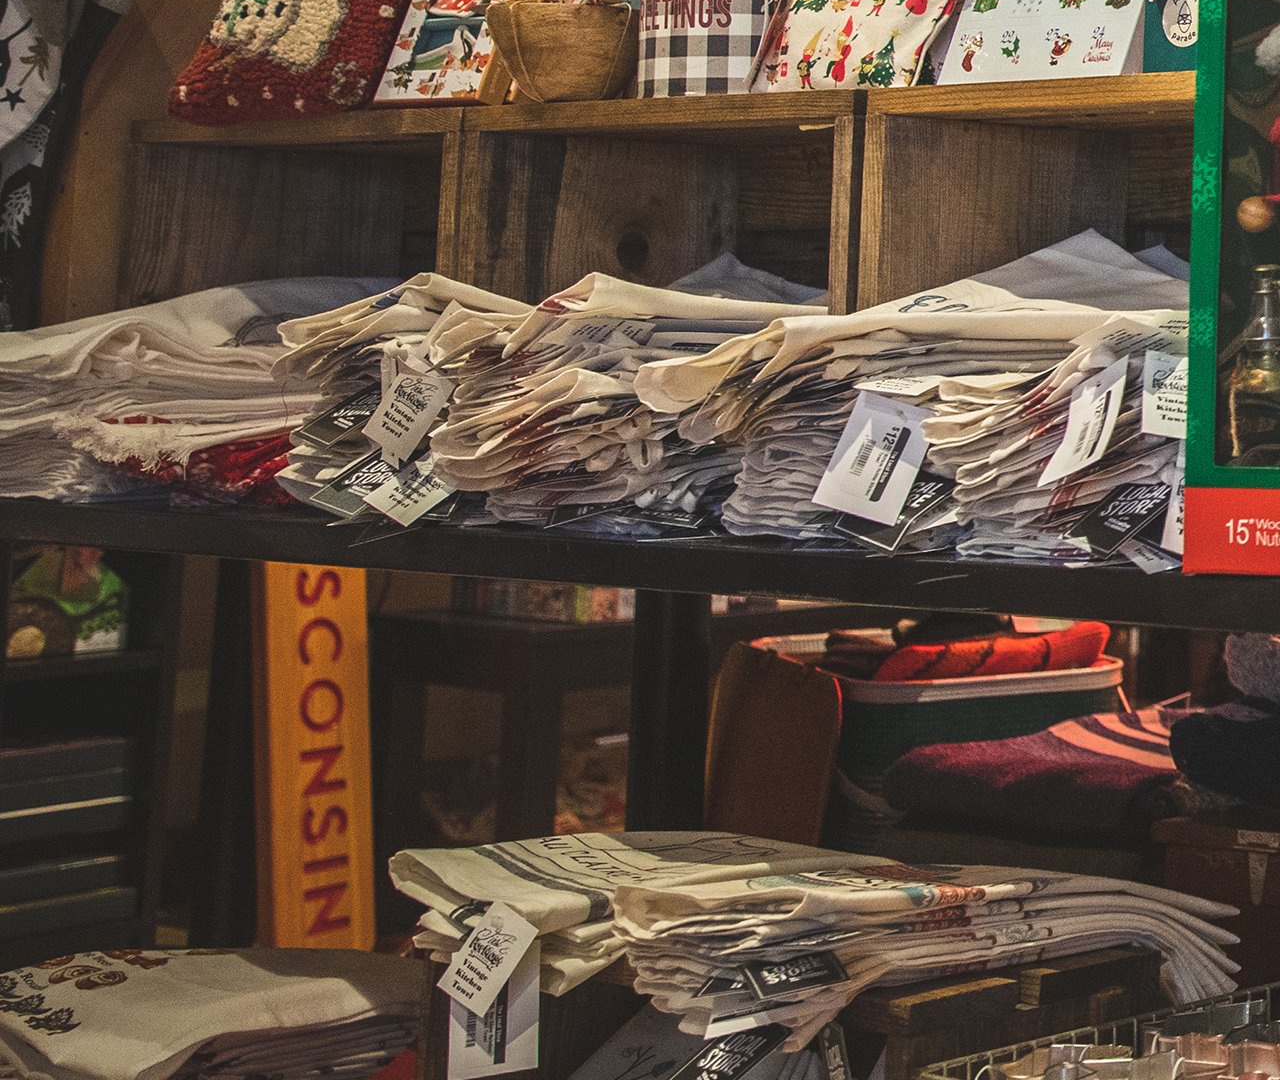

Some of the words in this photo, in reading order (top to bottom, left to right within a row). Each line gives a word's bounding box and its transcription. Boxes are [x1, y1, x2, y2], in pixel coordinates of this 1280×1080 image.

[1171, 29, 1197, 42] parade
[1156, 405, 1187, 414] Kitche
[1158, 395, 1187, 406] Vinta
[383, 411, 410, 433] Kitchen
[390, 403, 415, 423] Vintage
[381, 421, 403, 439] Towel
[1118, 485, 1173, 501] LOCAL
[1101, 499, 1162, 517] STORE
[297, 569, 352, 939] SCONSIN
[462, 957, 489, 982] Vintage
[454, 967, 483, 993] Kitchen
[451, 980, 475, 1000] Towel
